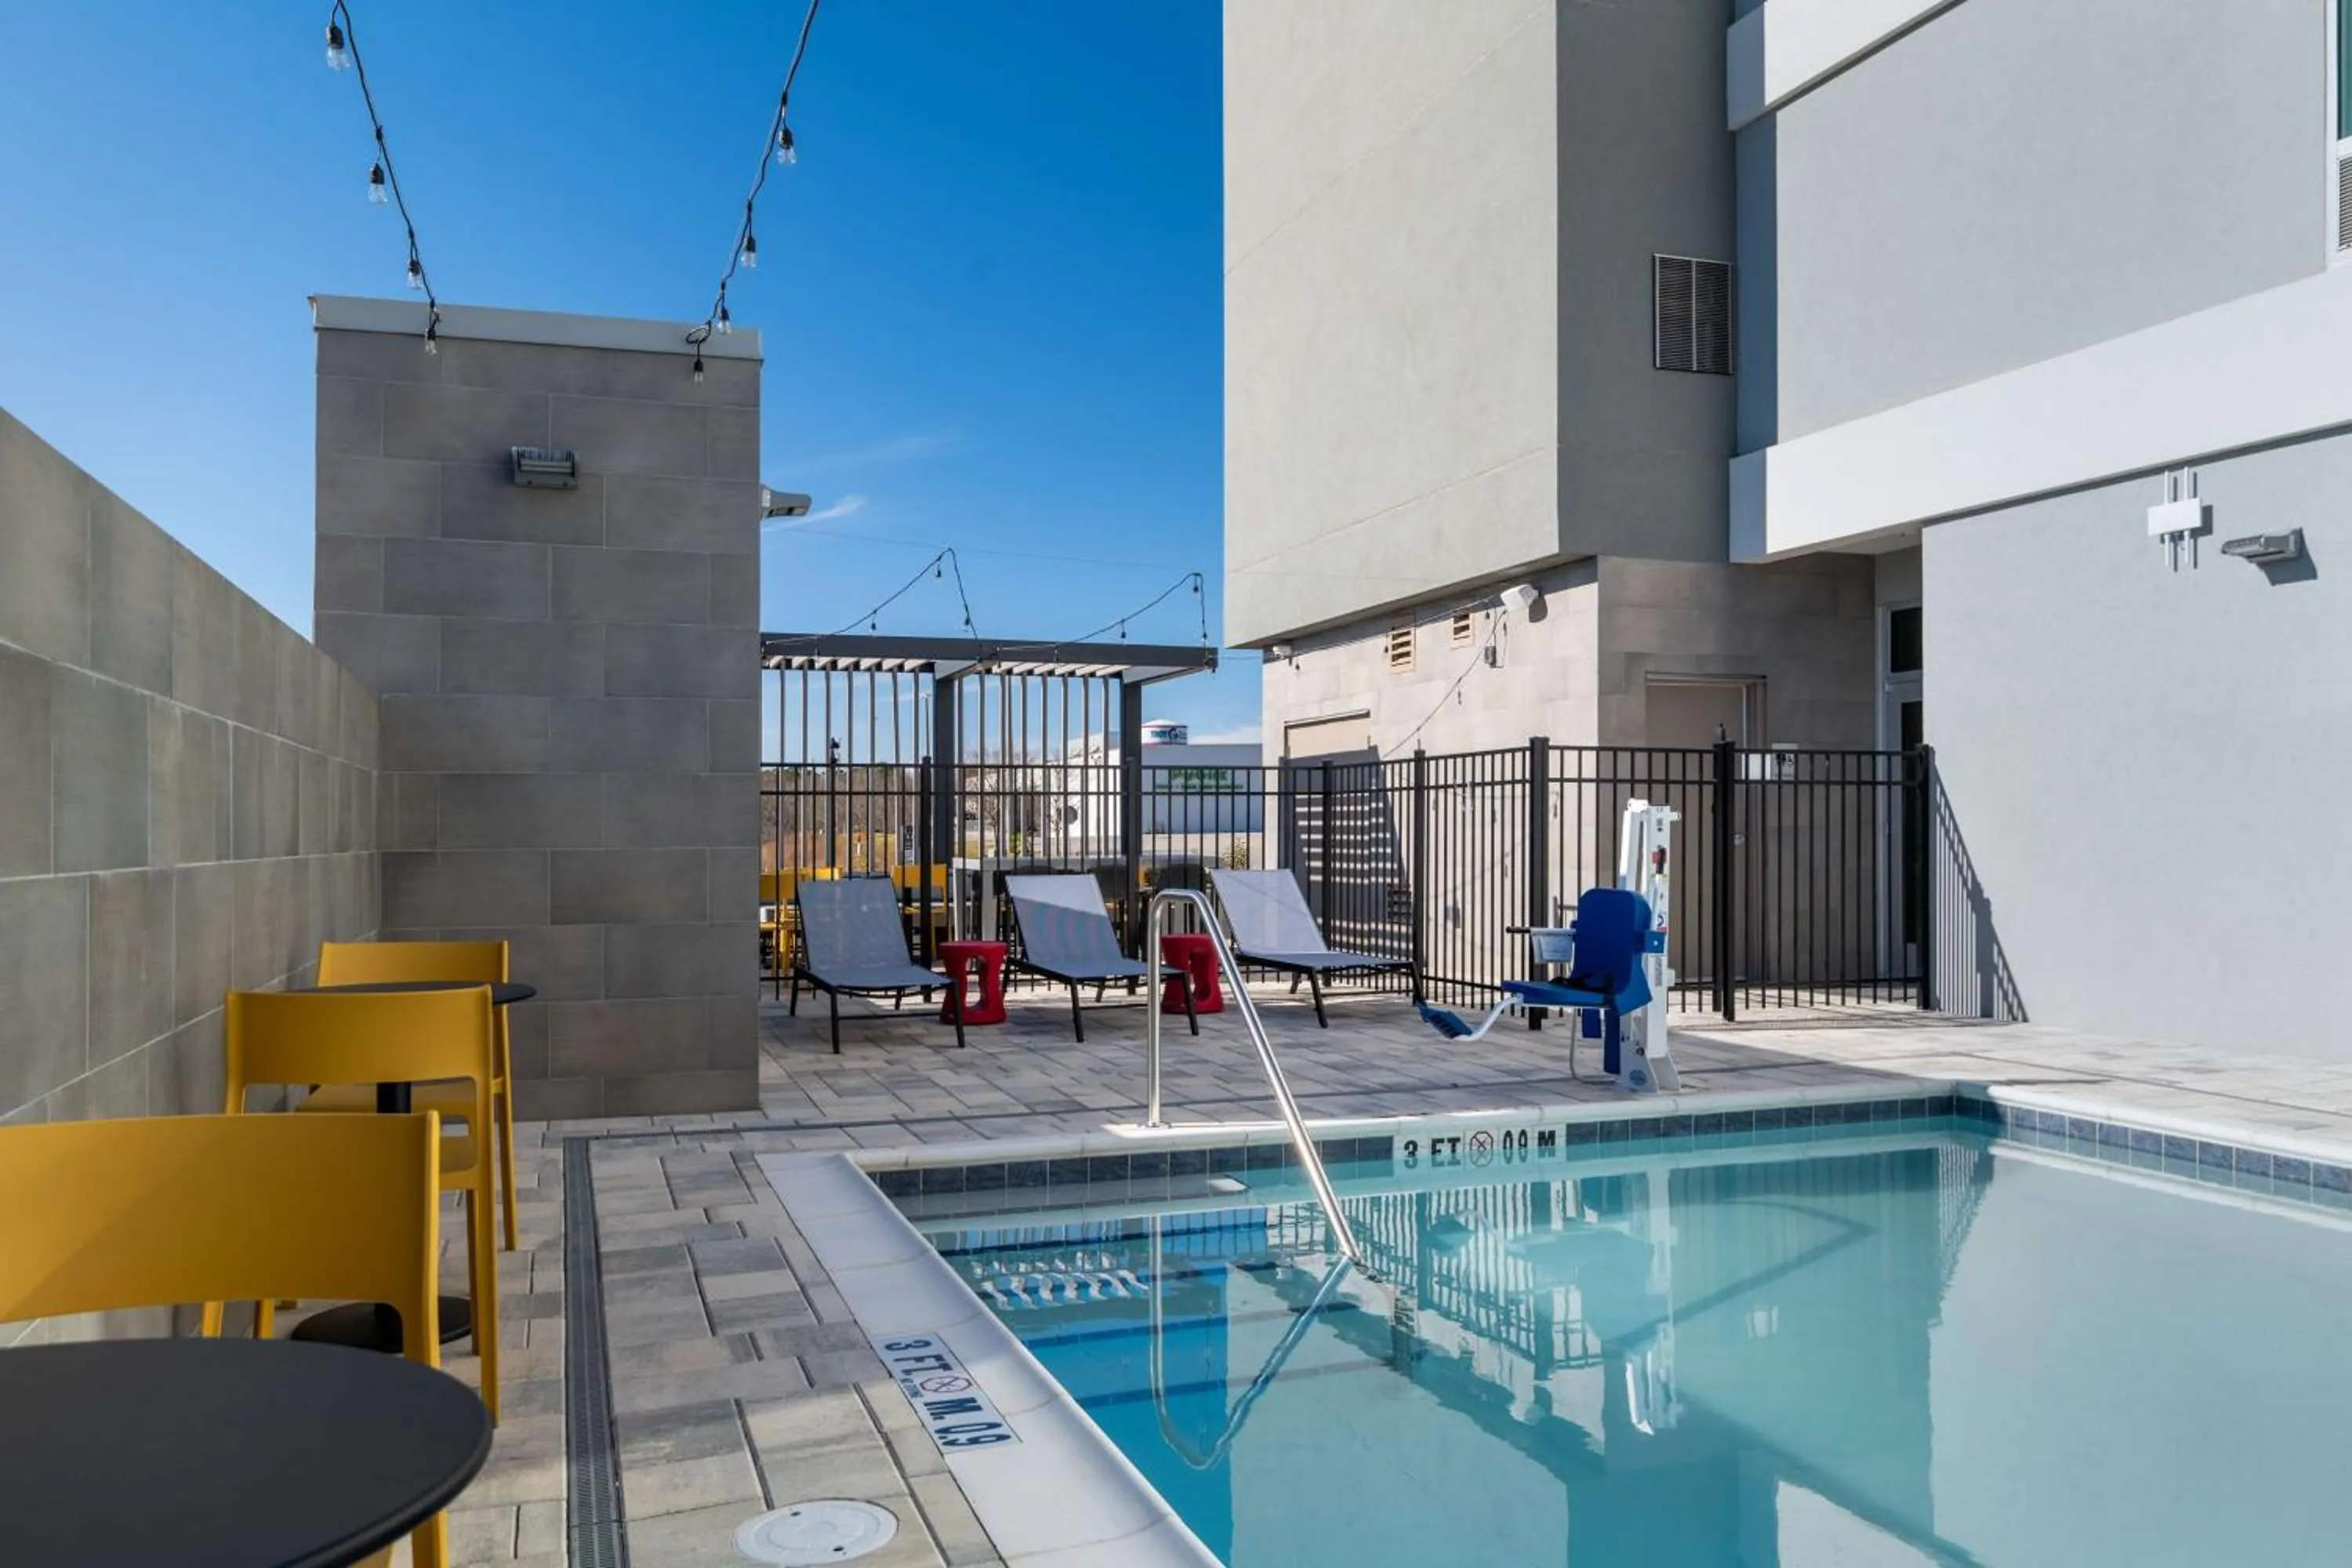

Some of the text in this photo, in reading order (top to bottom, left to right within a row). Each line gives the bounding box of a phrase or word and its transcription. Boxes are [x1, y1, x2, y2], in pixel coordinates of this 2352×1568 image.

[1403, 1140, 1418, 1160] 3
[1537, 1130, 1556, 1149] M
[884, 1339, 932, 1352] 3
[934, 1421, 1011, 1446] 0.9
